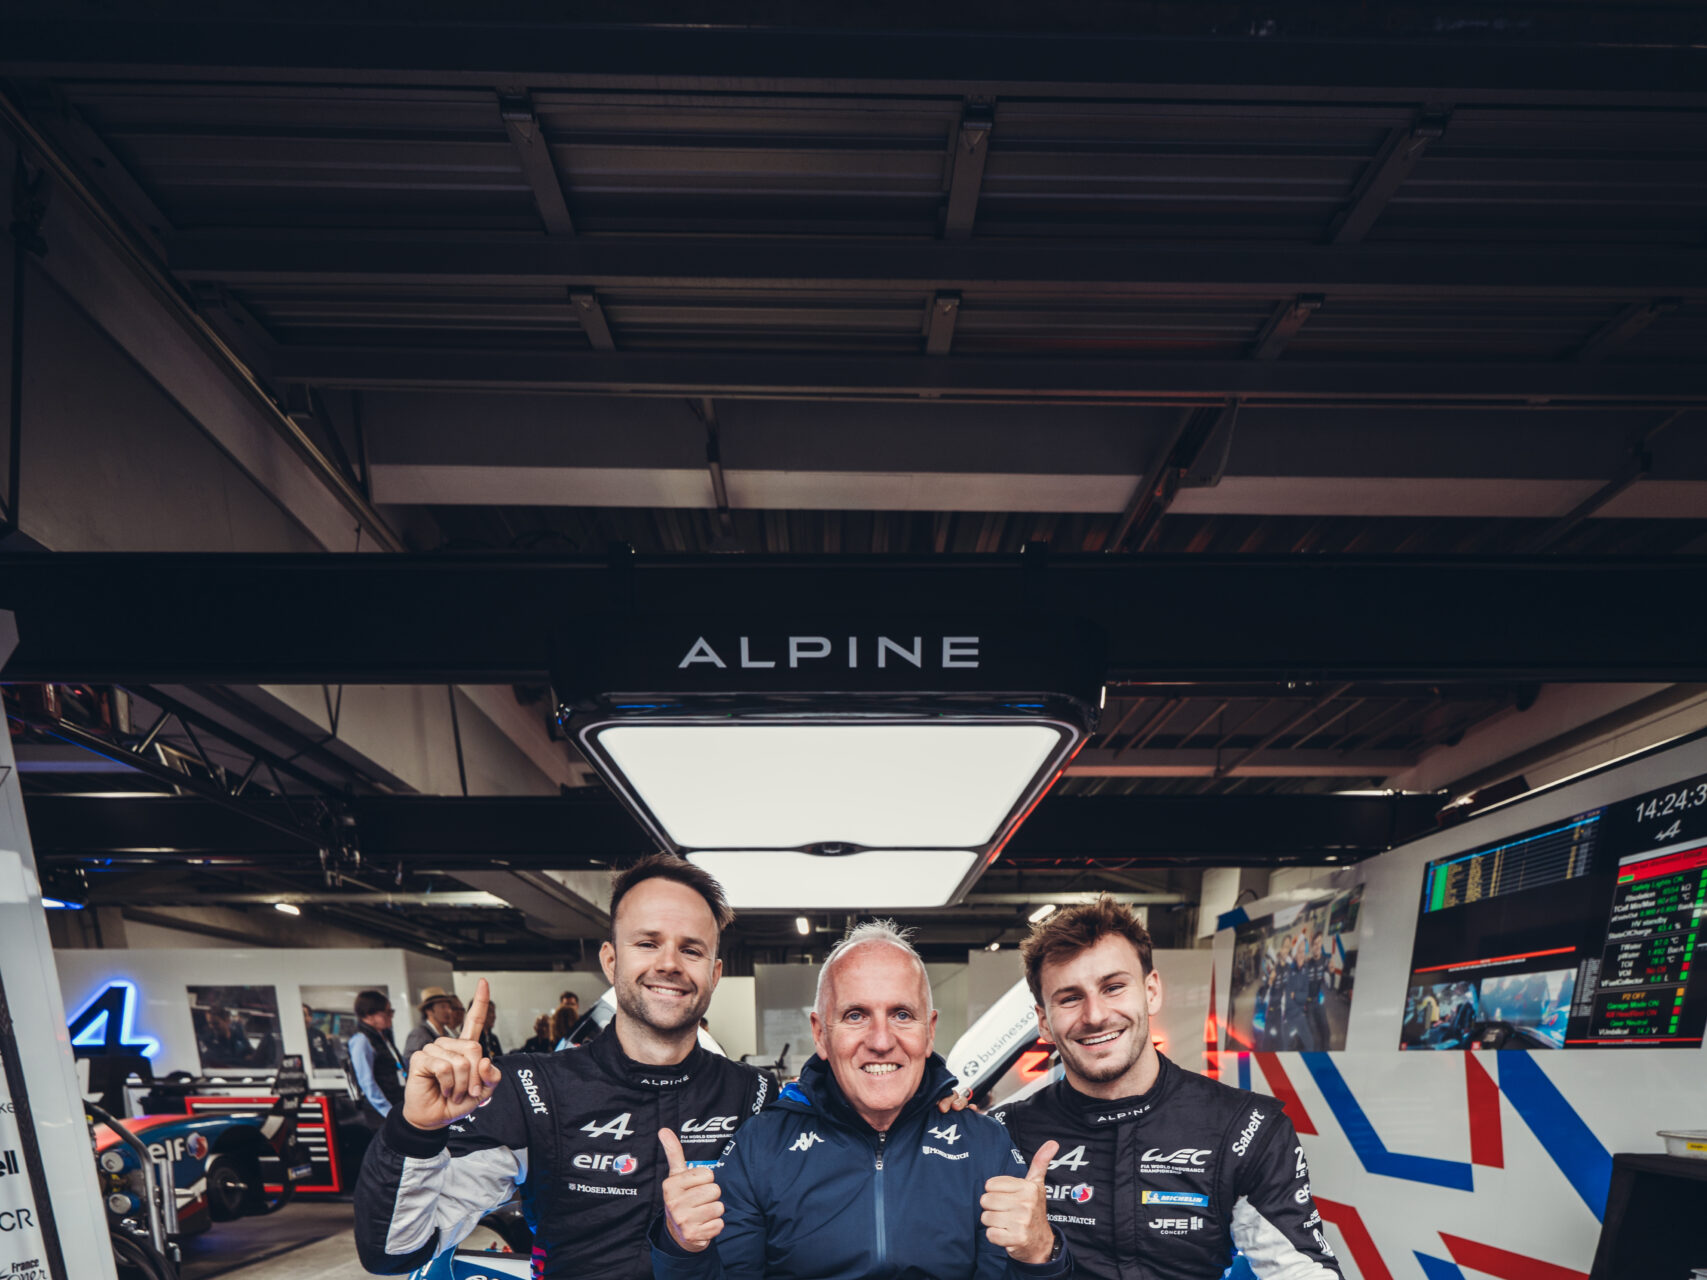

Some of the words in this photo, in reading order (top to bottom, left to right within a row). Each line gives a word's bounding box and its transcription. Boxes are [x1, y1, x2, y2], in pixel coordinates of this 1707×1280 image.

[678, 636, 980, 669] ALPINE
[640, 1074, 690, 1086] ALPINE
[517, 1069, 549, 1115] Sabelt
[752, 1073, 768, 1115] Sabelt
[681, 1115, 738, 1132] WEC
[1232, 1108, 1265, 1157] Sabelt
[148, 1137, 185, 1163] elf
[1141, 1148, 1213, 1165] WEC
[573, 1153, 614, 1171] elf
[1160, 1195, 1203, 1203] MICHELIN
[11, 1258, 40, 1274] France
